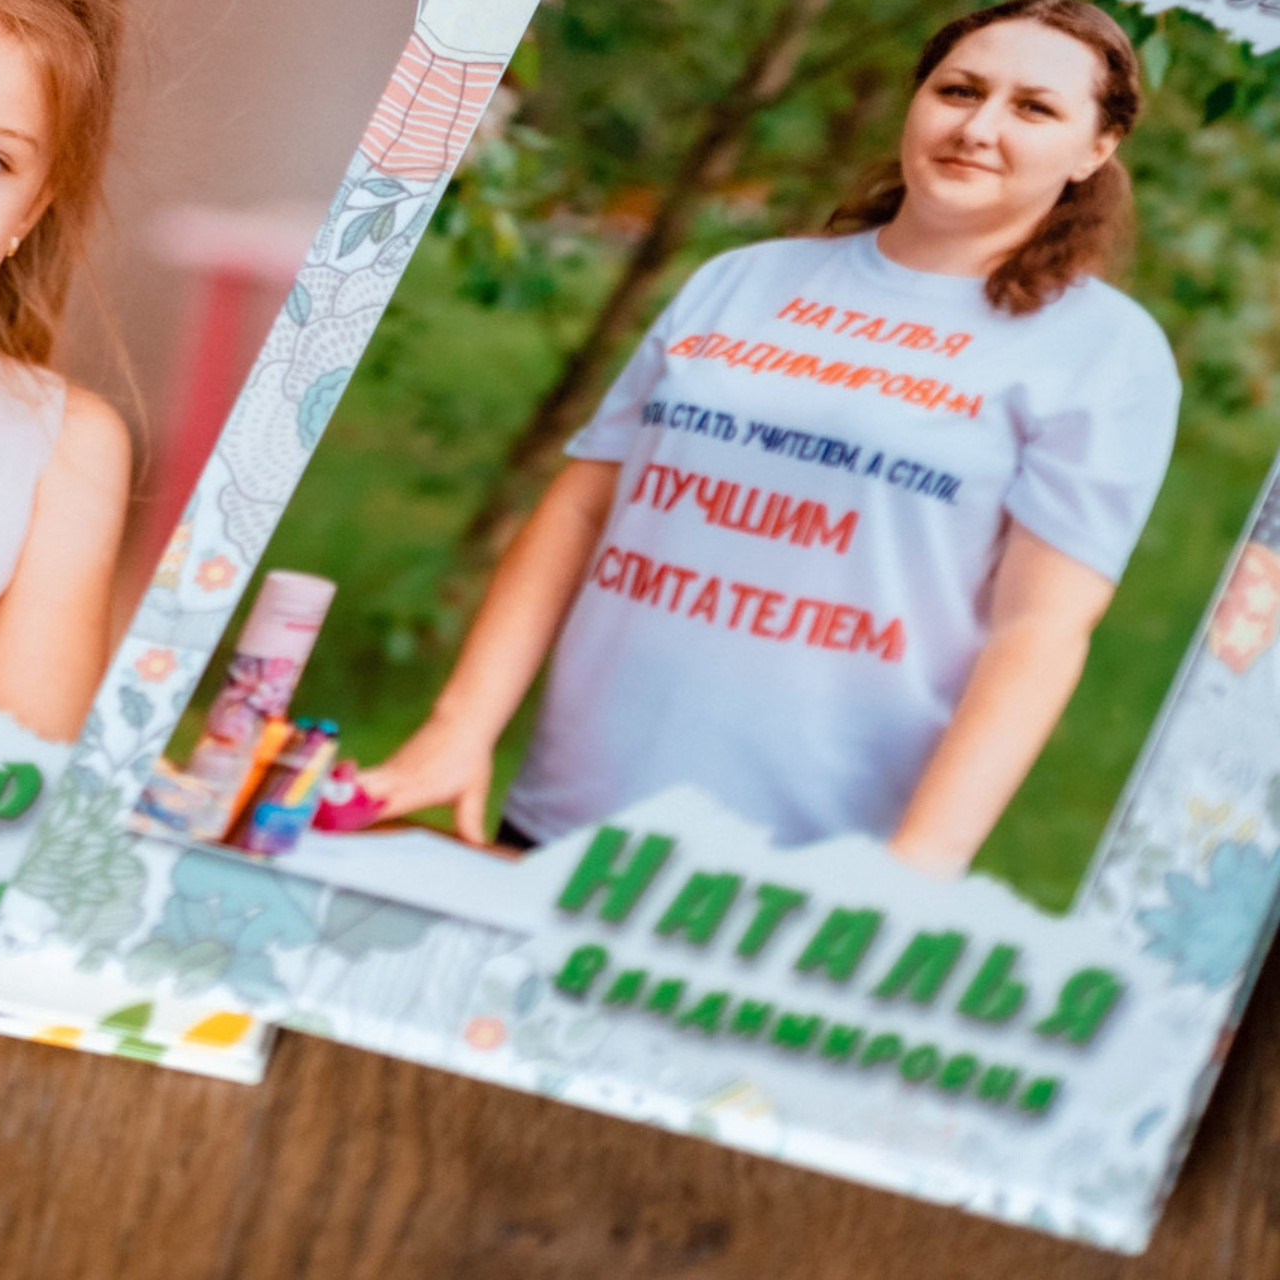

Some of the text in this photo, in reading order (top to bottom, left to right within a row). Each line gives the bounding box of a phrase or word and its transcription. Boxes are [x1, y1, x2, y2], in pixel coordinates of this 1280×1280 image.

[776, 297, 973, 358] НАТАЛЬЯ
[669, 402, 738, 442] СТАТЬ
[865, 451, 885, 479] А
[631, 463, 859, 555] ЛУЧШИМ
[595, 546, 907, 663] СПИТАТЕЛЕМ
